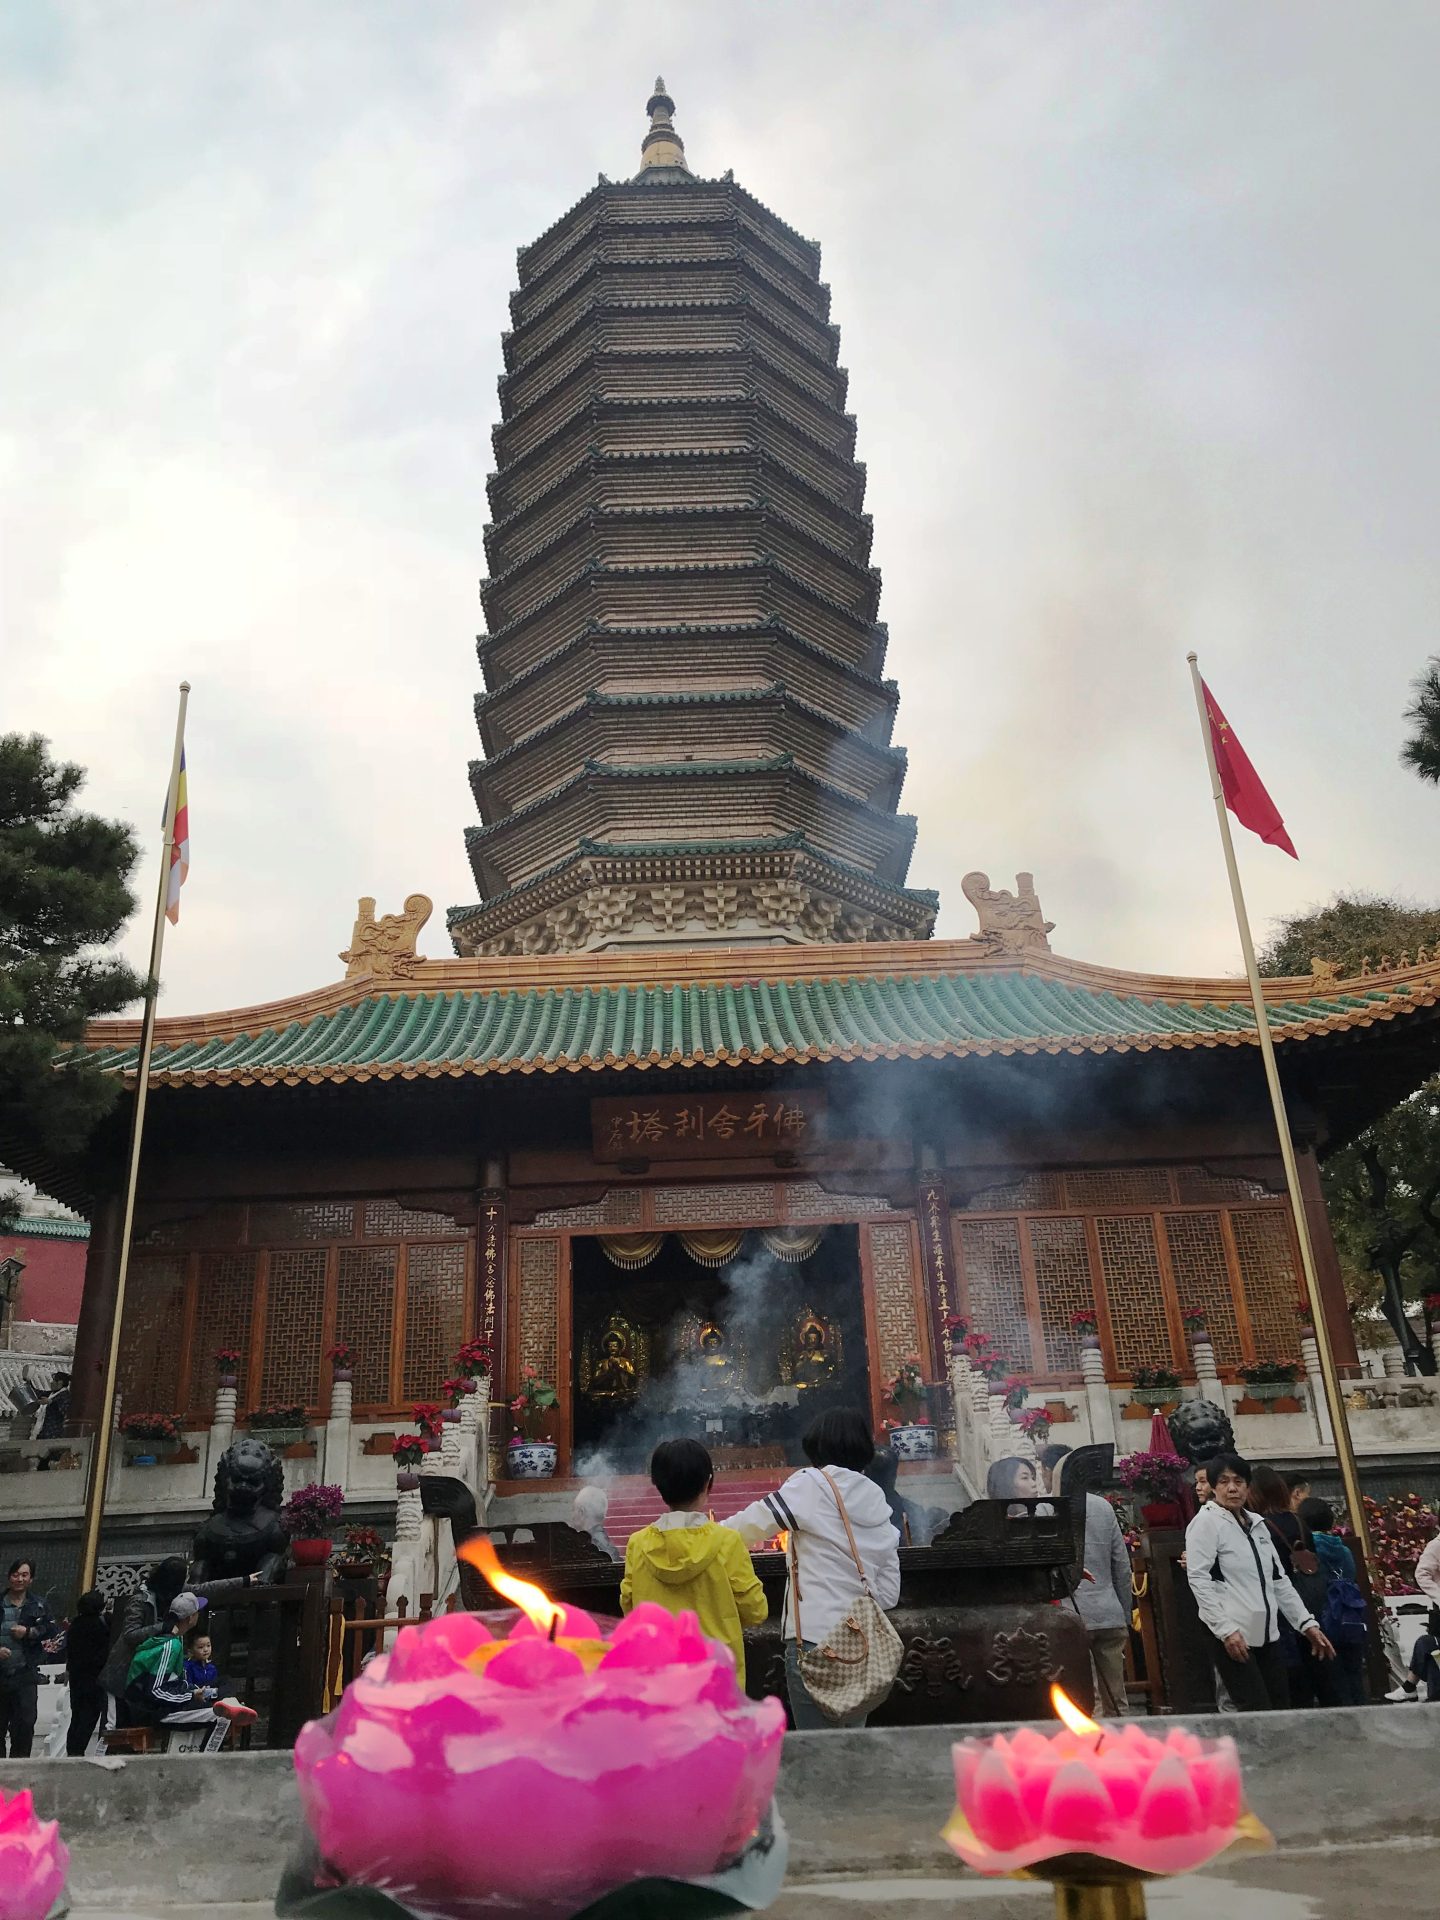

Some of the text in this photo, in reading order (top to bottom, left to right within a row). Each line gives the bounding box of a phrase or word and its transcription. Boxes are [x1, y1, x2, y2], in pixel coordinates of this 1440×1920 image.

[625, 1102, 808, 1144] 佛牙舍利塔
